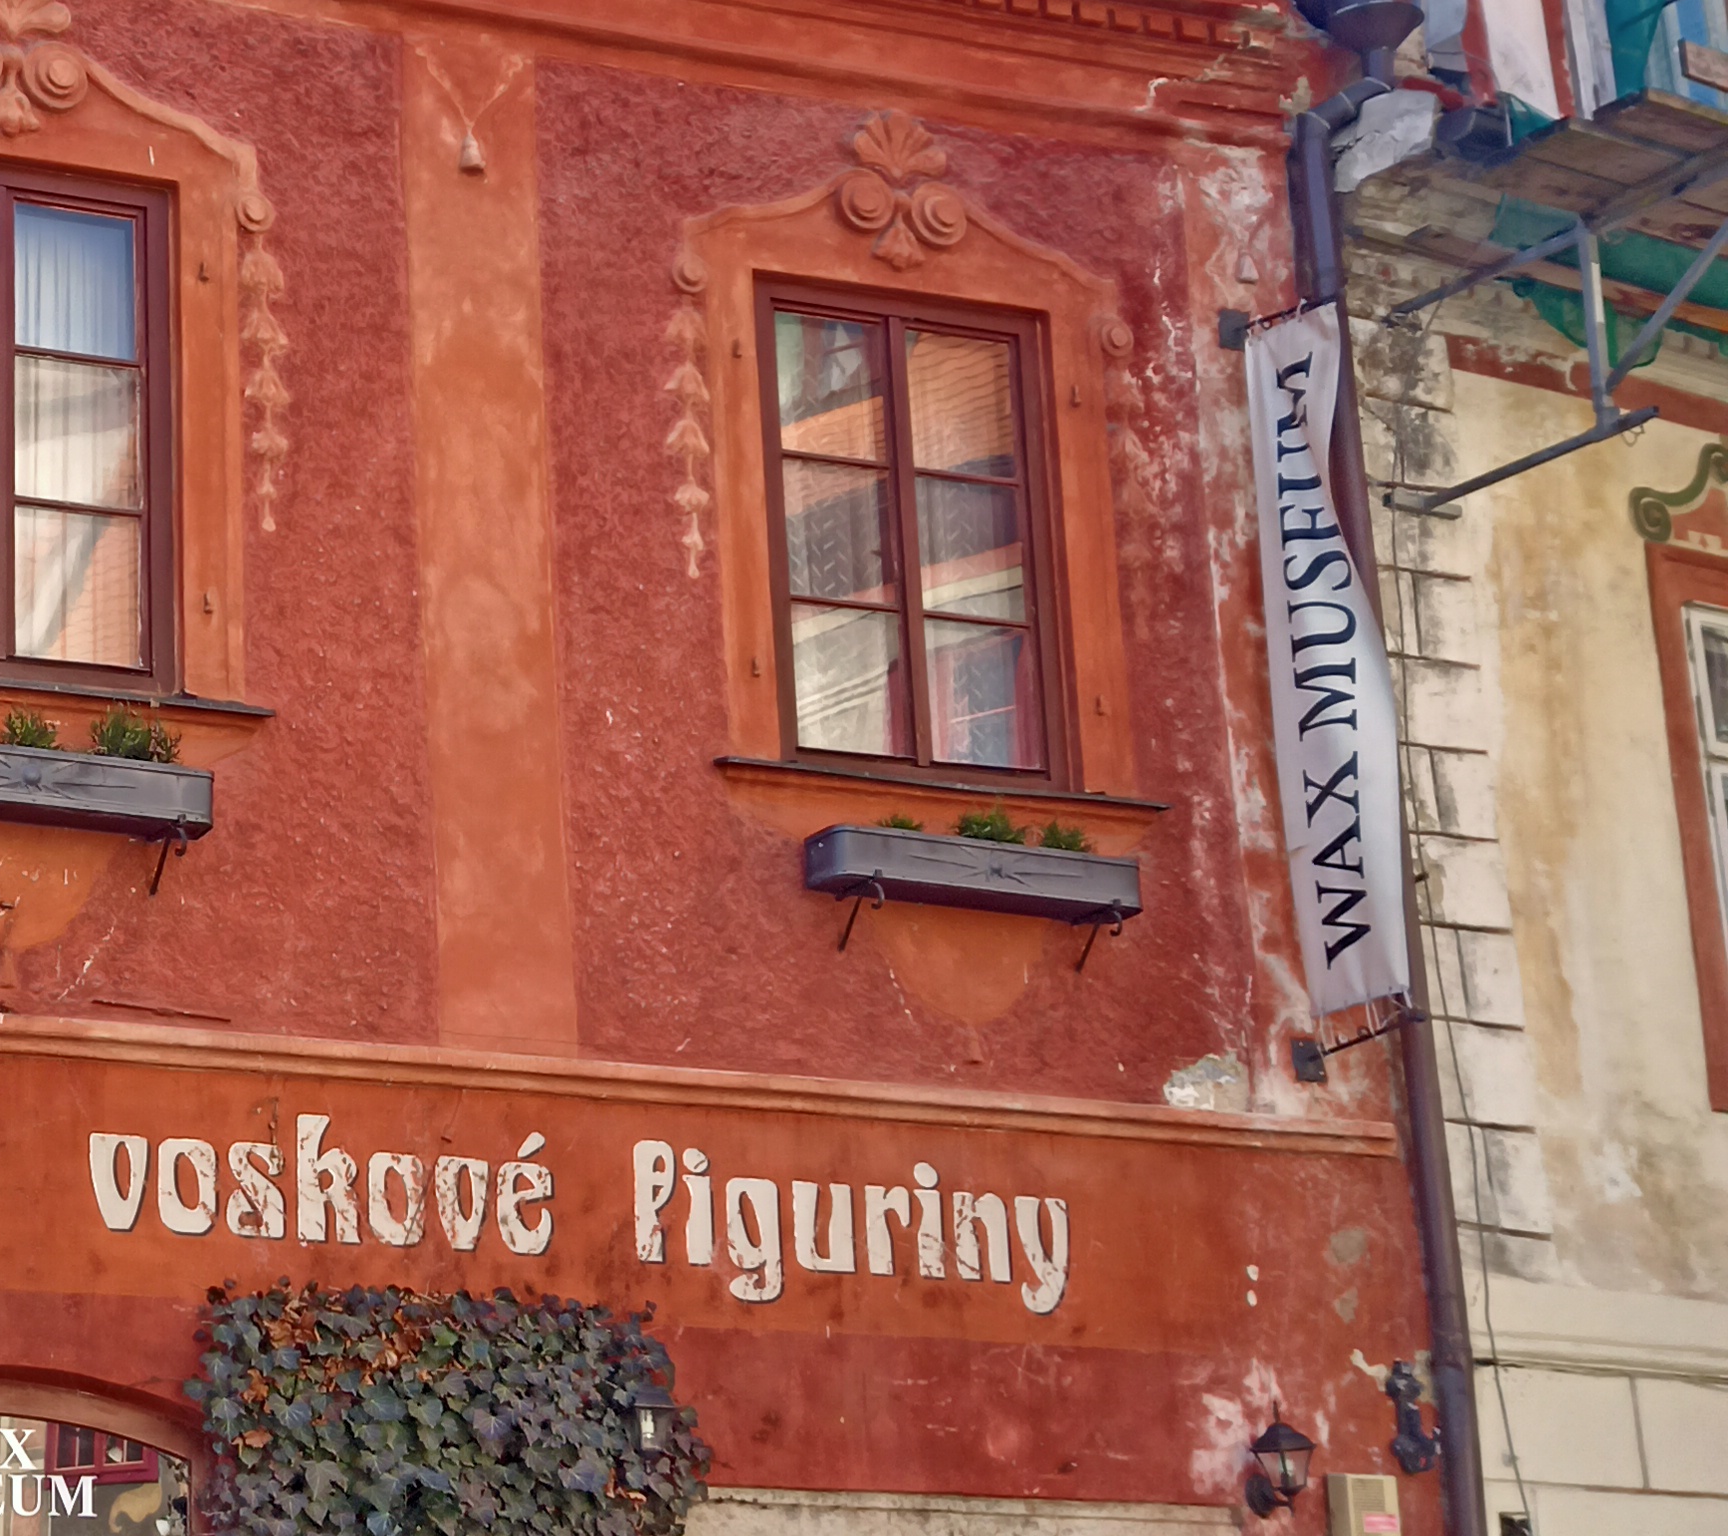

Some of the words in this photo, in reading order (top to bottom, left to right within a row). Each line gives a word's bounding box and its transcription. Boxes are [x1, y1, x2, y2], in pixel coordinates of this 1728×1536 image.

[1275, 350, 1358, 742] MUSEUM
[1303, 751, 1372, 969] WAX
[88, 1112, 555, 1257] voskové
